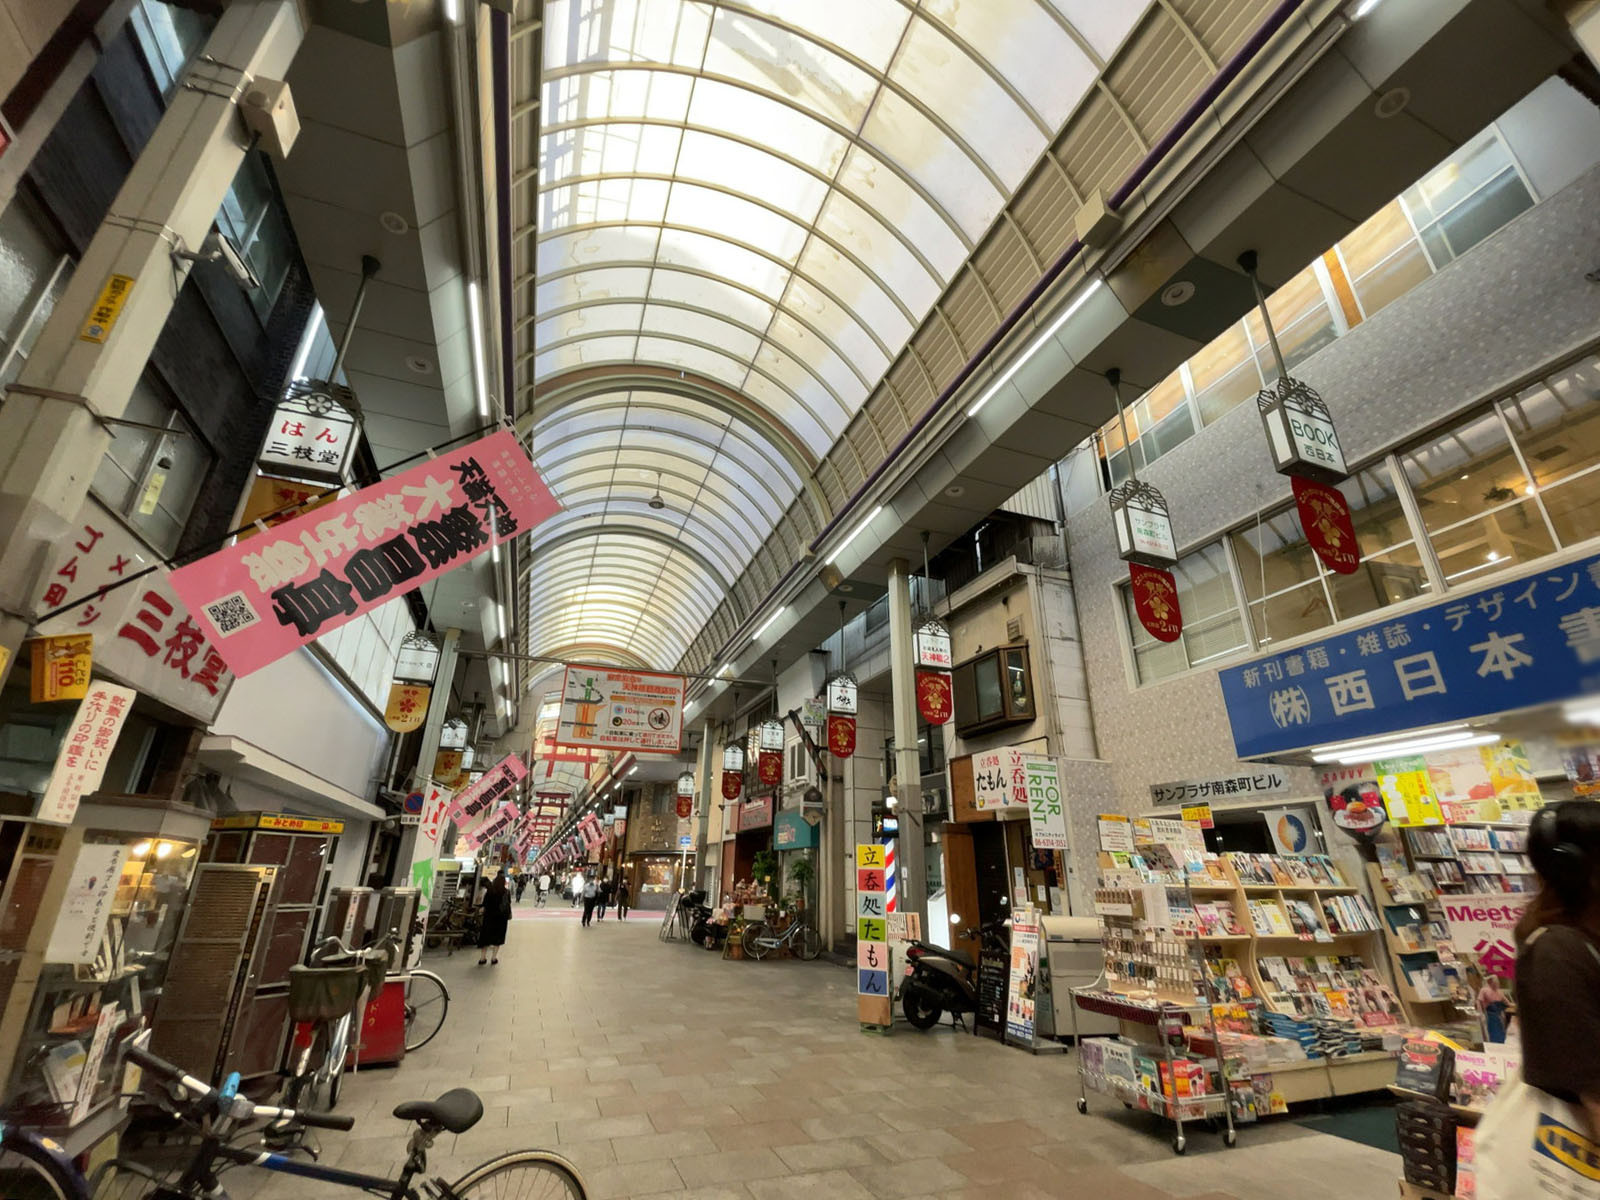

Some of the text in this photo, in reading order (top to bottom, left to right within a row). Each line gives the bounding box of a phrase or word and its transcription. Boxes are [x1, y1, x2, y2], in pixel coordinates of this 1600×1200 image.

[1291, 418, 1338, 450] BOOK
[265, 441, 339, 466] 三枝堂
[1303, 443, 1336, 464] 西日本
[270, 502, 490, 637] 繁昌亭
[118, 590, 228, 697] 三枝堂
[59, 660, 75, 687] 110
[976, 768, 1007, 792] たもん
[1153, 773, 1282, 803] サンプラザ南森町ビル
[1321, 767, 1364, 785] SAVVY
[1028, 774, 1047, 825] RENT
[1043, 775, 1061, 816] FOR
[861, 846, 882, 993] 立呑処たもん
[1446, 905, 1525, 922] Meets
